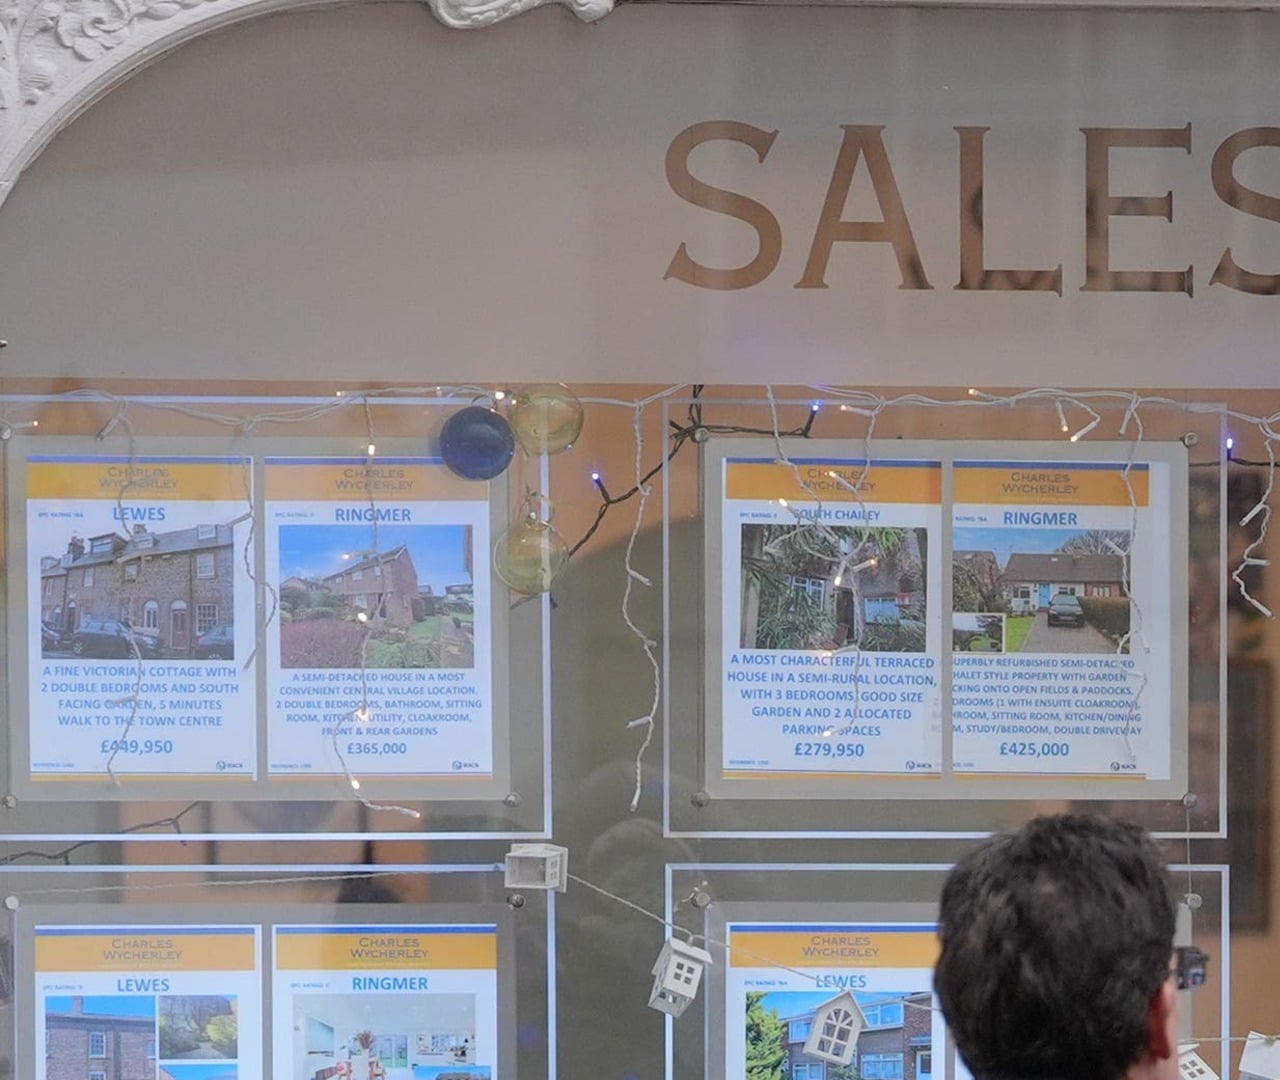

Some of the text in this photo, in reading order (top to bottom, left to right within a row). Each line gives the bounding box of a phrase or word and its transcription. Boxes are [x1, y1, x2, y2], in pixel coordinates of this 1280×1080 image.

[1011, 472, 1070, 483] CHARLES
[1002, 483, 1079, 494] WYCHERLEY
[113, 508, 165, 520] LEWES
[336, 509, 411, 521] RINGMER
[1004, 512, 1077, 526] RINGMER
[41, 682, 238, 694] 2 DOUBLE BEDROOMS AND SOUTH
[752, 706, 911, 719] GARDEN AND 2 ALLOCATED
[101, 740, 172, 754] £449,950
[347, 743, 407, 756] £365,000
[795, 743, 864, 758] £279,950
[1000, 742, 1069, 758] £425,000
[112, 938, 173, 949] CHARLES
[359, 937, 420, 948] CHARLES
[812, 936, 870, 946] CHARLES
[104, 950, 182, 960] WYCHERLEY
[350, 949, 428, 959] WYCHERLEY
[803, 947, 879, 957] WYCHERLEY
[118, 979, 170, 992] LEWES
[352, 977, 428, 990] RINGMER
[816, 975, 866, 988] LEWES
